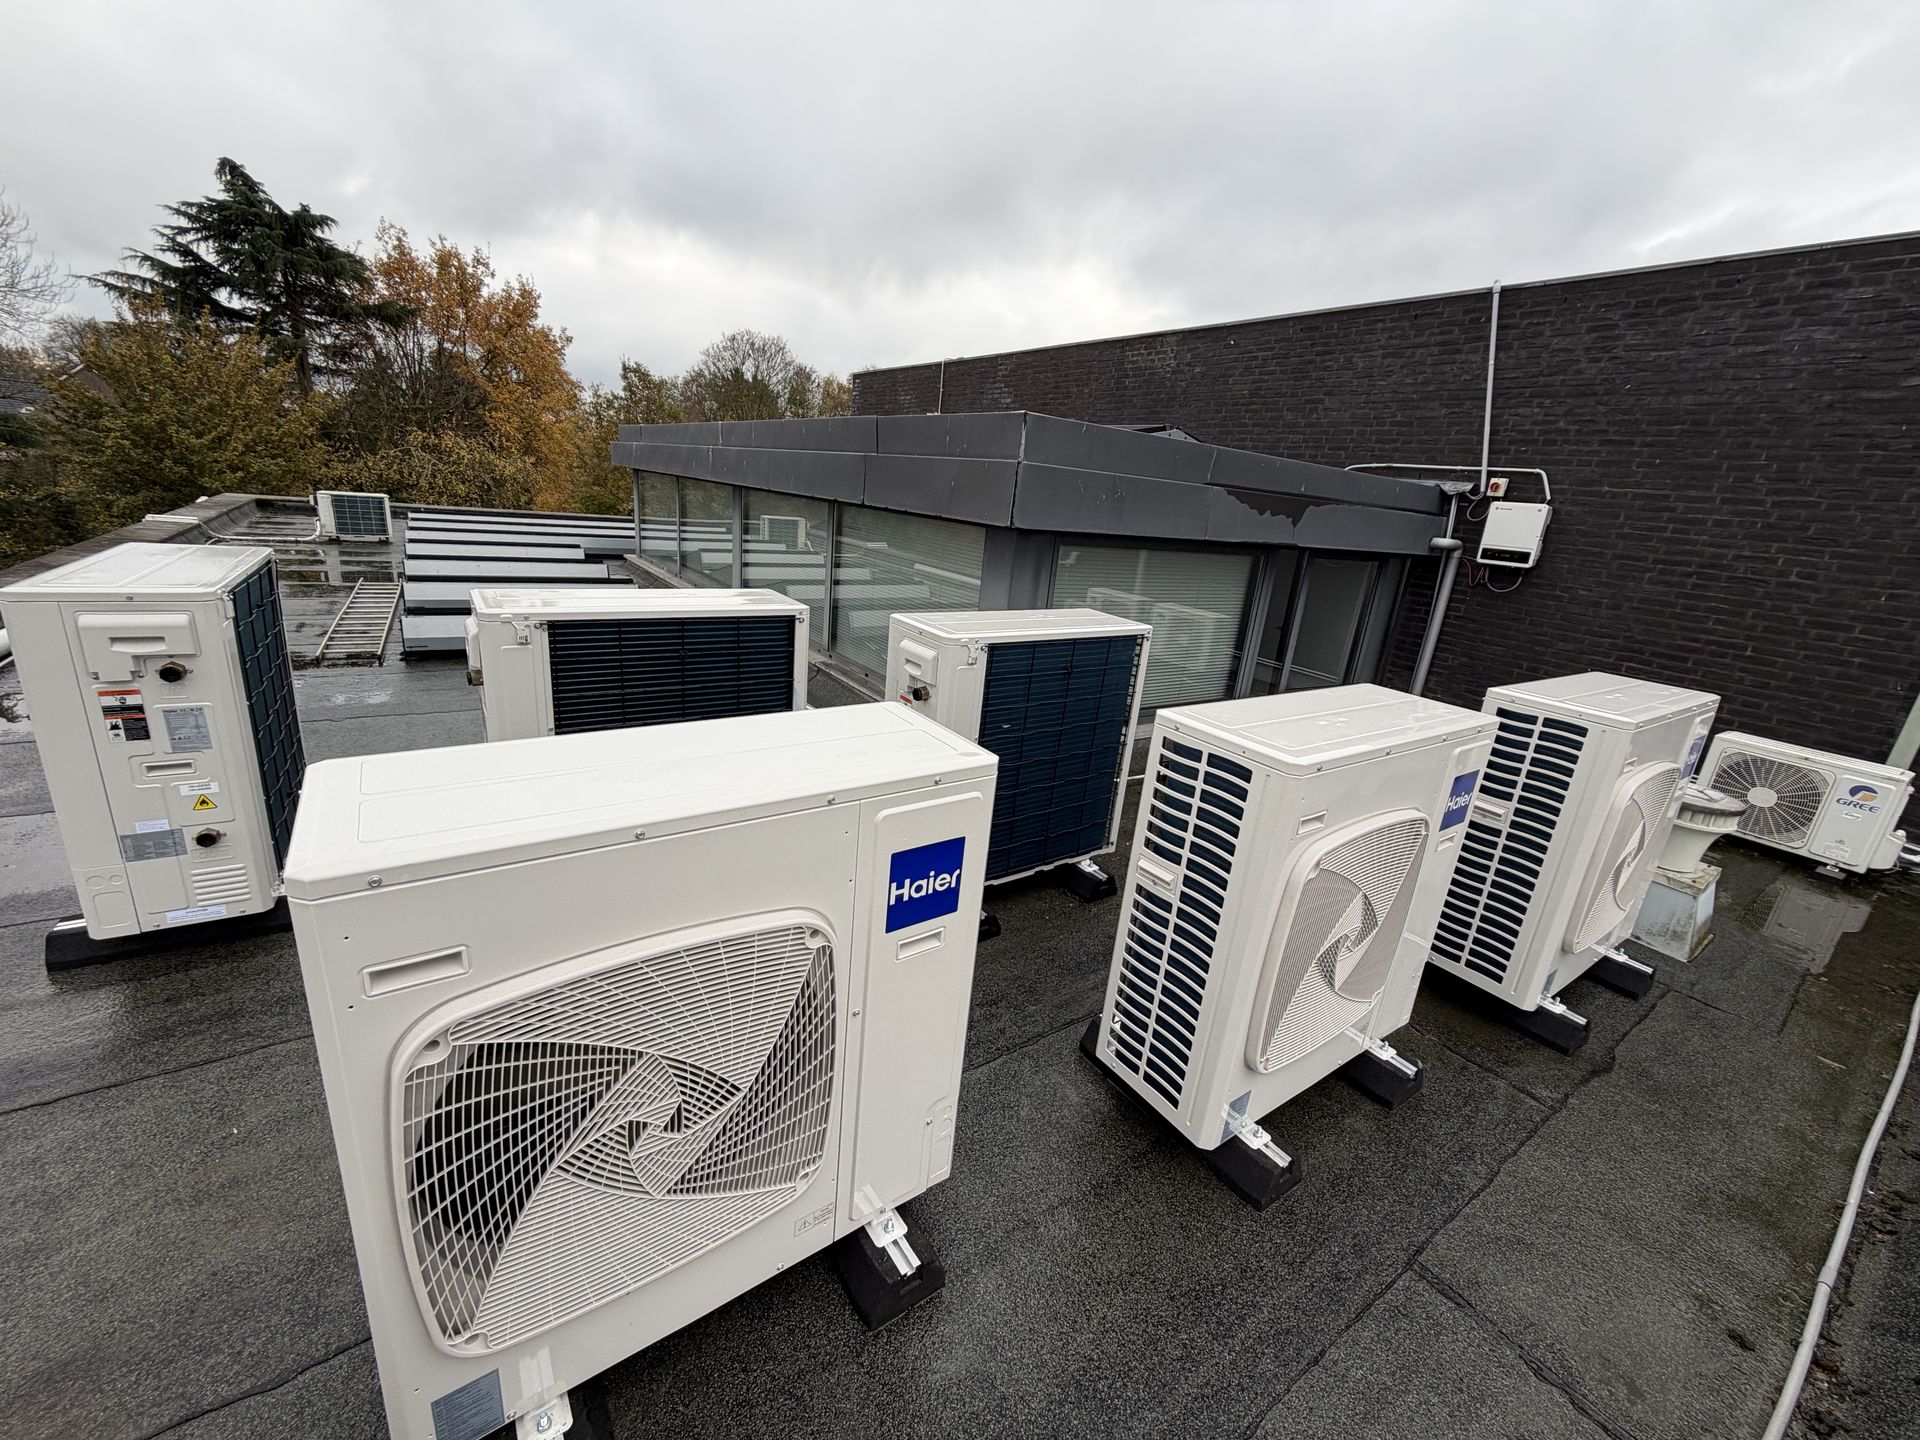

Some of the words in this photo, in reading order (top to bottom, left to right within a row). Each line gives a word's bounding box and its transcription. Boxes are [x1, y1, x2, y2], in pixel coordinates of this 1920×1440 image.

[1445, 791, 1473, 813] Haier
[1836, 797, 1881, 814] GREE
[889, 868, 961, 906] Haier
